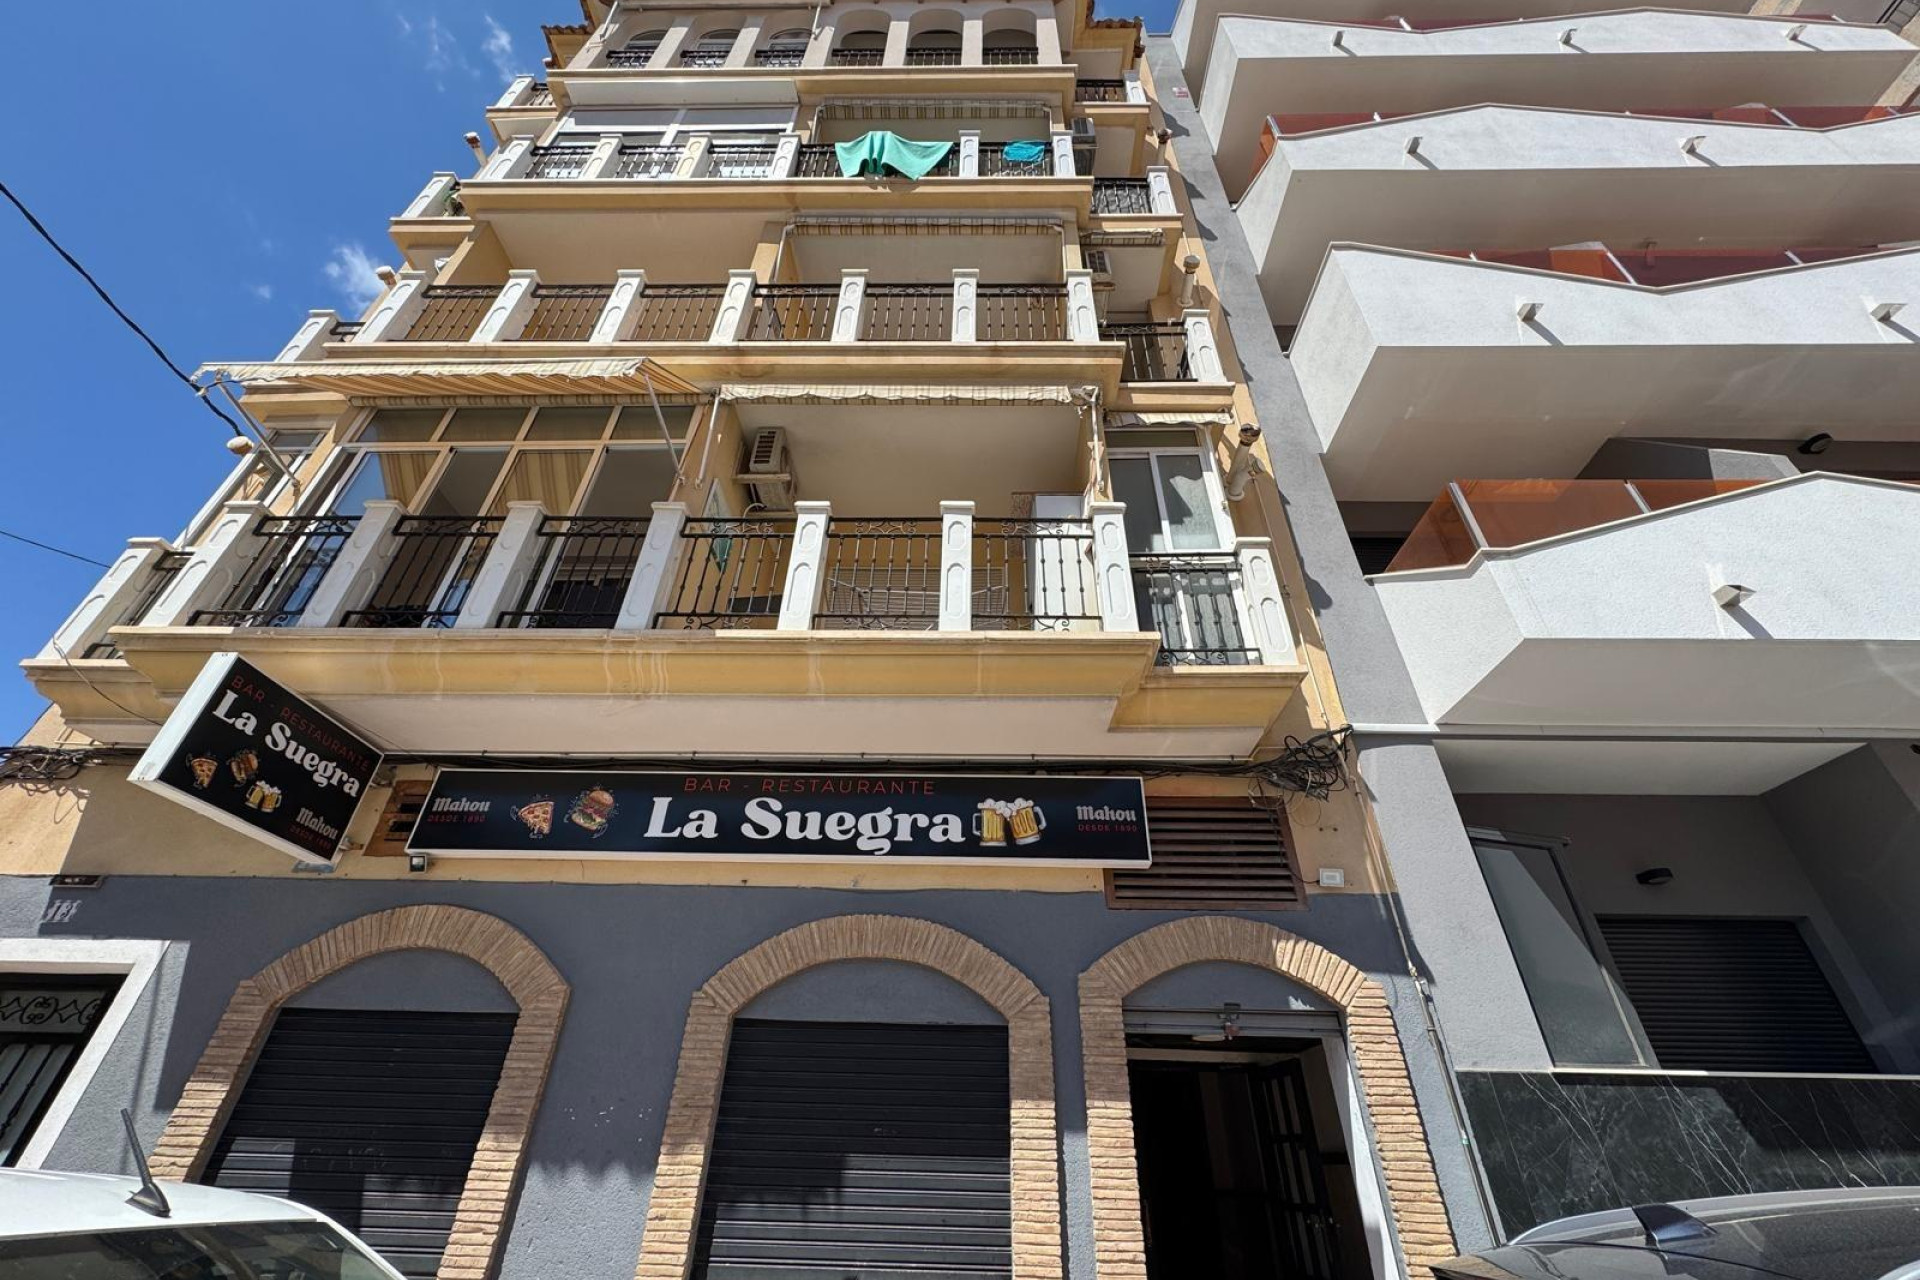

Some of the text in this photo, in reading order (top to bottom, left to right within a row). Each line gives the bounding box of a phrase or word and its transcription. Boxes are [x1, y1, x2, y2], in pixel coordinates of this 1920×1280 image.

[231, 675, 265, 702] BAR
[280, 707, 372, 771] RESTAURANTE
[212, 689, 361, 797] La Suegra
[684, 777, 730, 792] BAR
[762, 778, 935, 796] RESTAURANTE
[431, 797, 491, 813] Mahou
[1076, 805, 1136, 821] Mahou
[296, 807, 339, 840] Mahou
[643, 796, 966, 856] La Suegra
